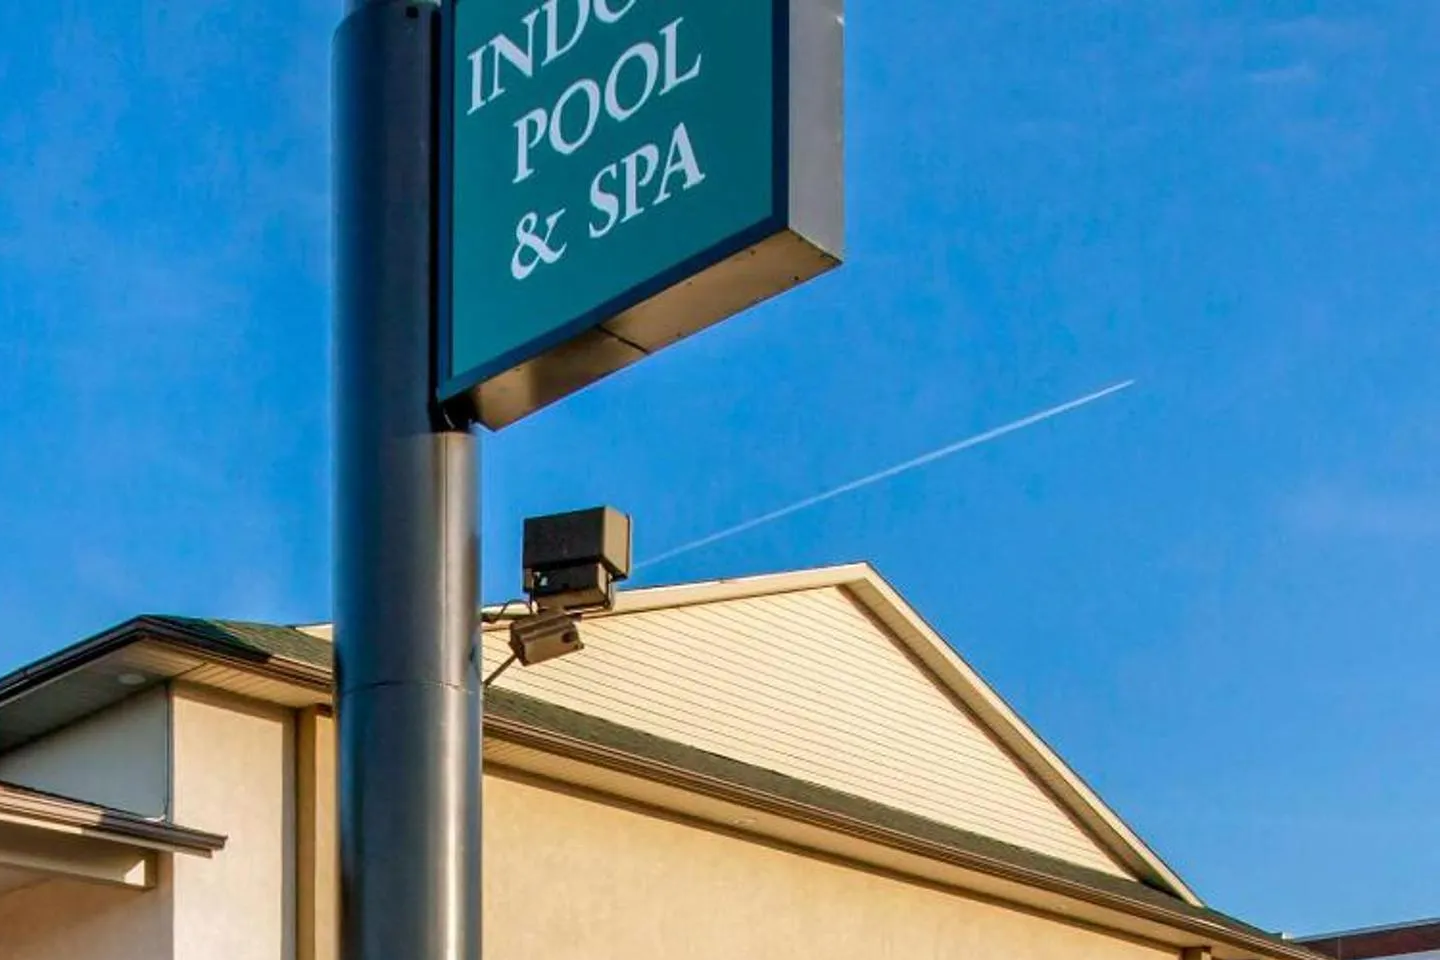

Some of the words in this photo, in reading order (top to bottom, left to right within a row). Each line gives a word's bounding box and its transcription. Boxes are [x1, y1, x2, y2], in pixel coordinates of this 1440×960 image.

[513, 17, 702, 184] POOL
[511, 208, 567, 280] &
[588, 122, 705, 238] SPA
